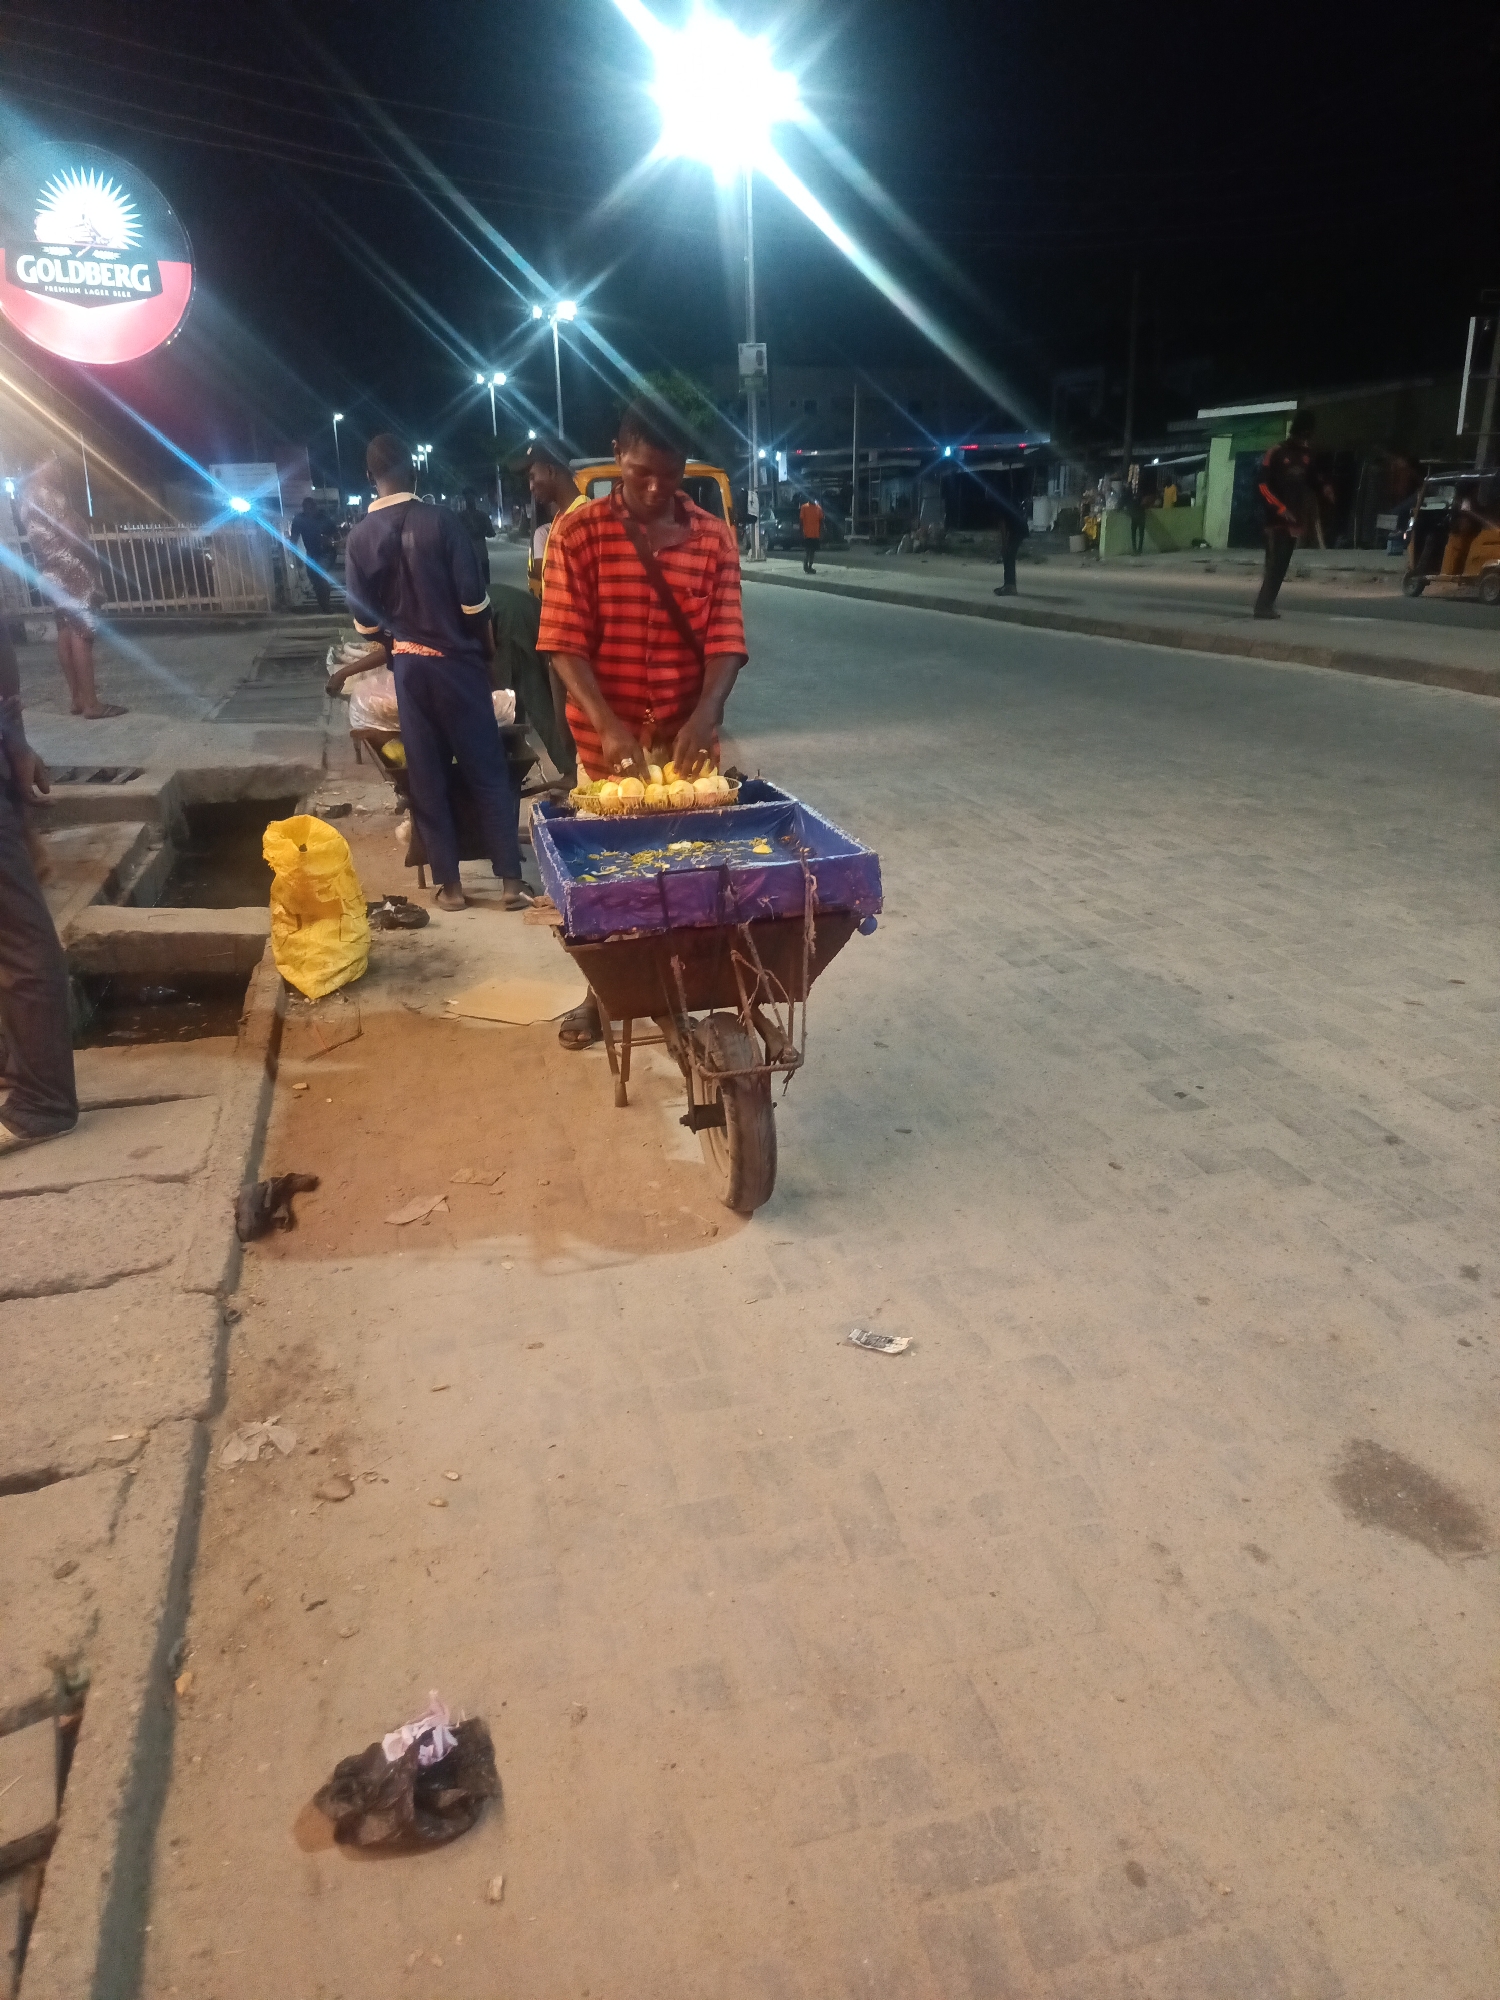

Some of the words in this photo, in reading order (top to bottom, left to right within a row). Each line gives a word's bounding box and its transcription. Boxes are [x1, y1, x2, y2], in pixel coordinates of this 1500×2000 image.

[16, 254, 151, 292] GOLDBERG
[44, 285, 81, 294] PREMIUM
[84, 288, 110, 297] LAGER
[112, 290, 132, 298] BEER
